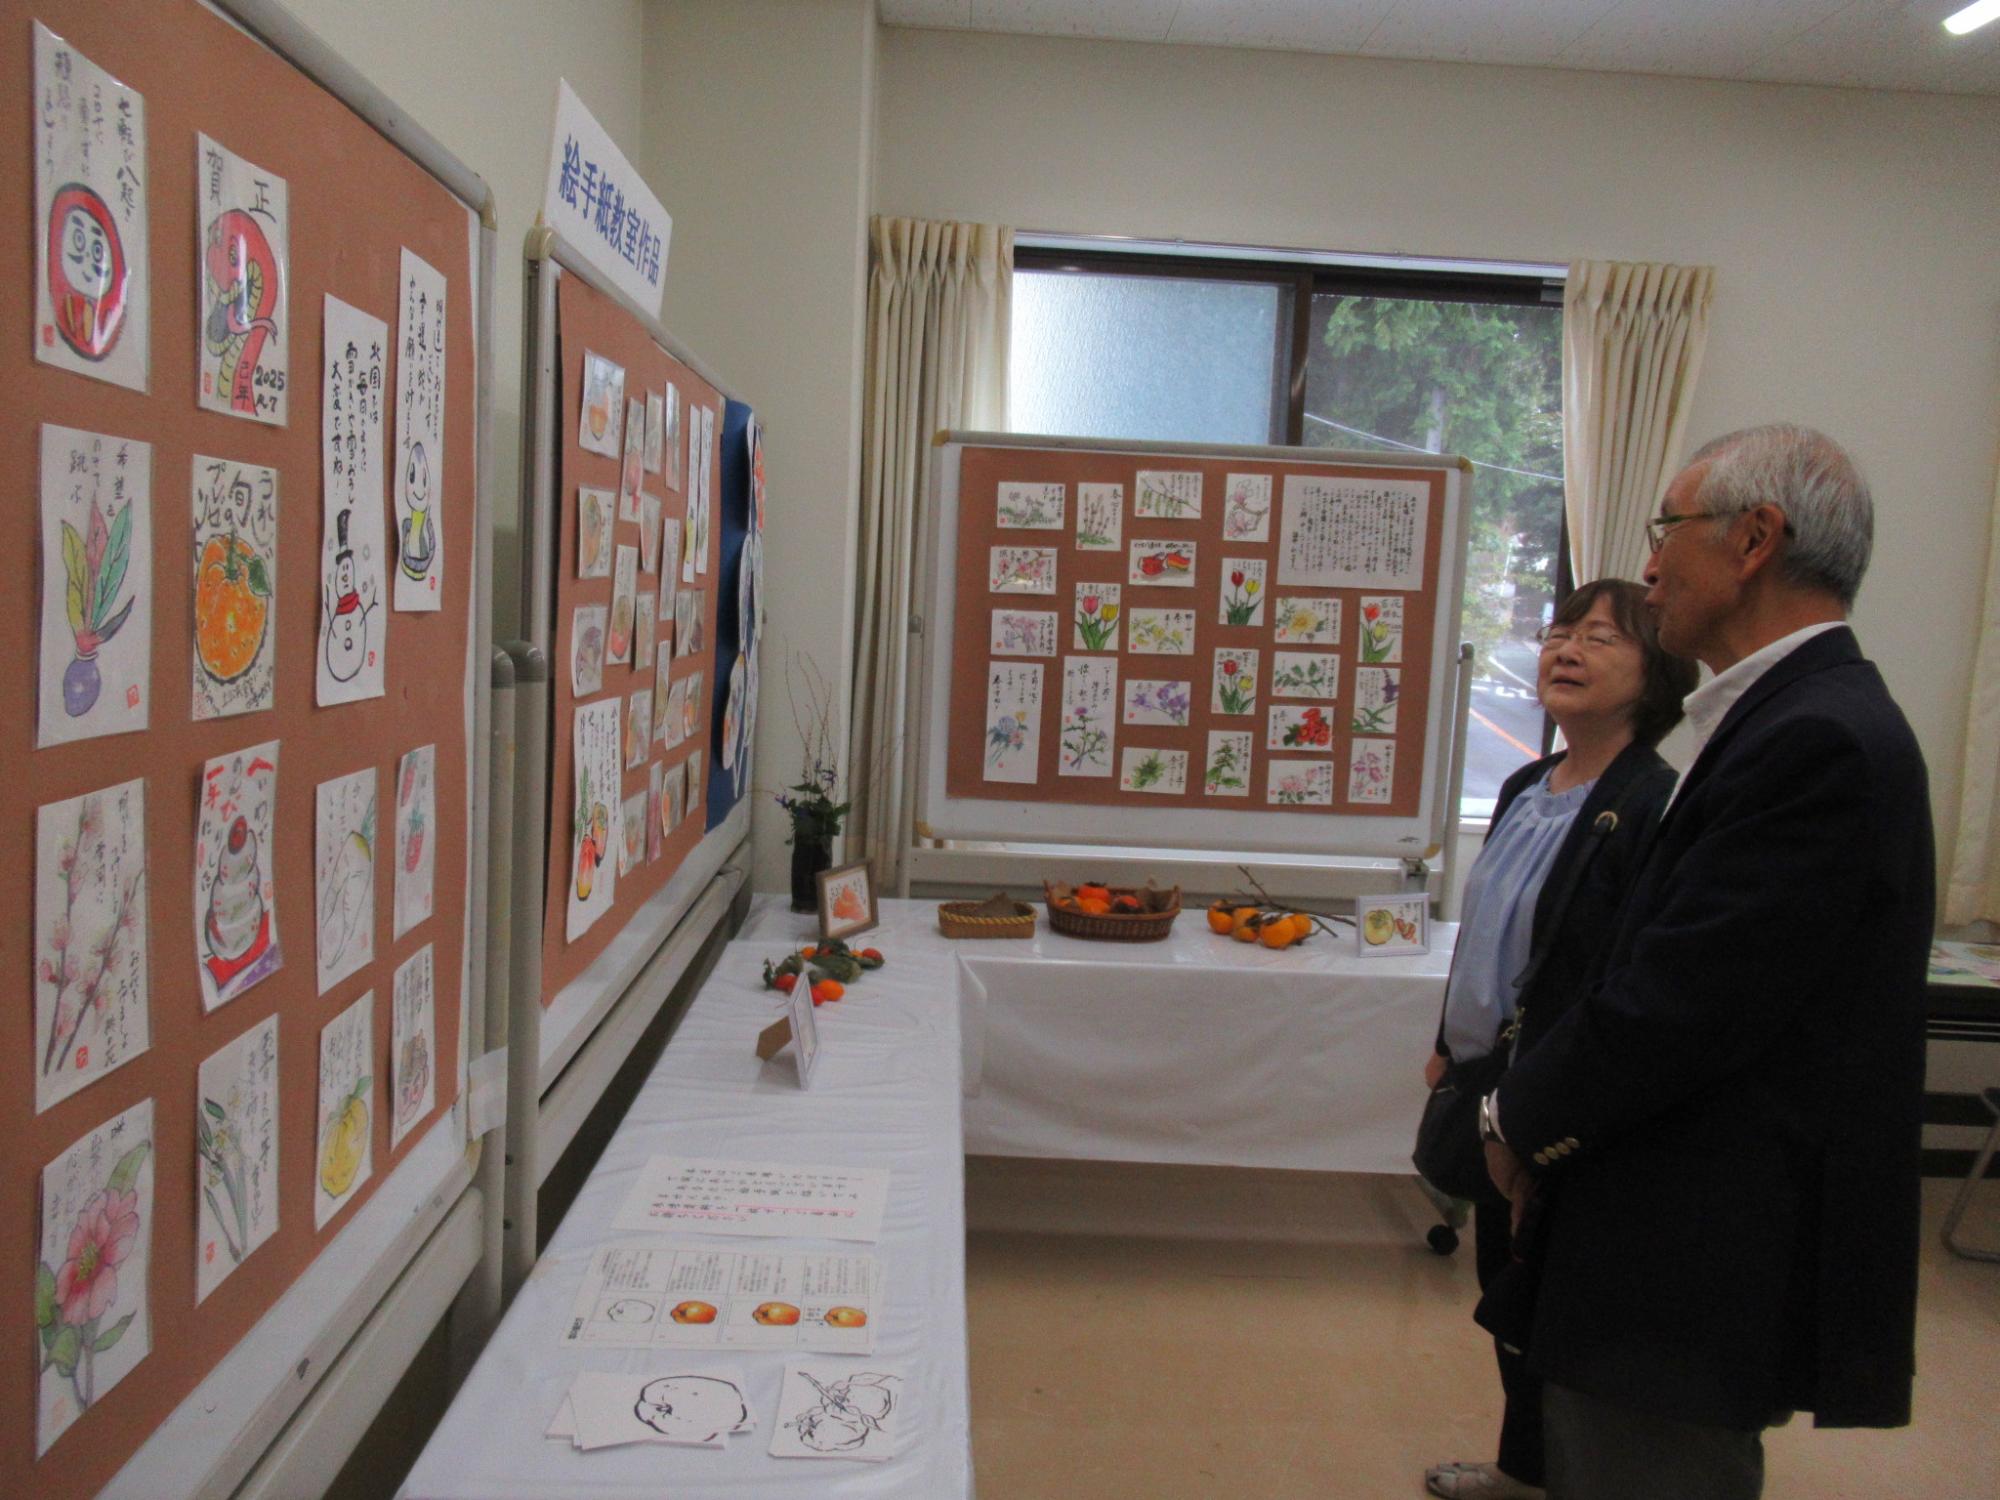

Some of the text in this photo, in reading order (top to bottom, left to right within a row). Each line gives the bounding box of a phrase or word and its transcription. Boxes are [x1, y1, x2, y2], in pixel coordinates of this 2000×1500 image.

[559, 133, 661, 287] 絵手紙教室作品
[254, 363, 286, 392] 2025
